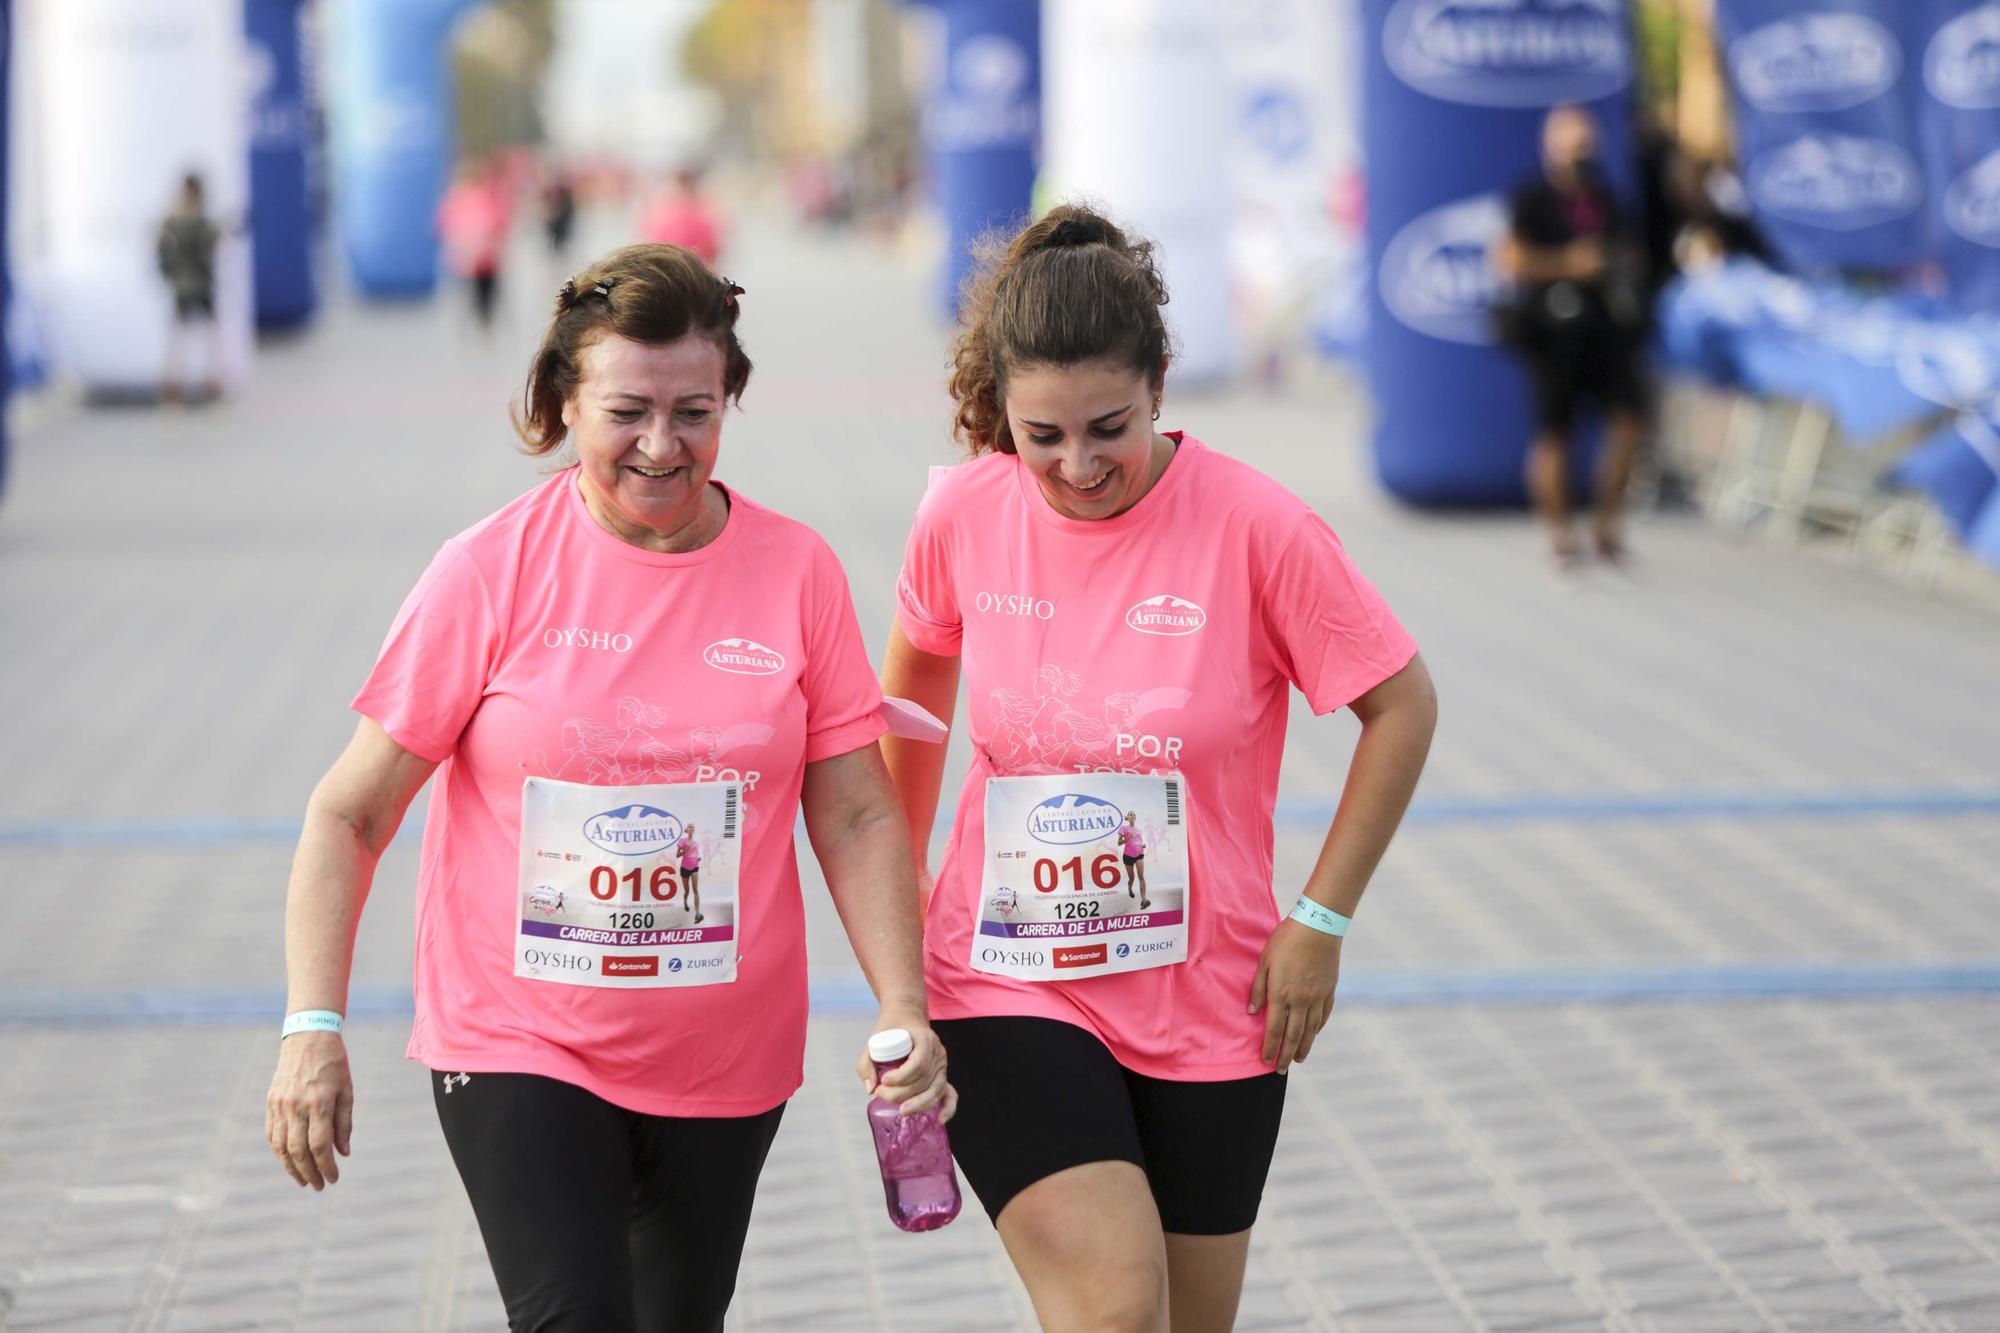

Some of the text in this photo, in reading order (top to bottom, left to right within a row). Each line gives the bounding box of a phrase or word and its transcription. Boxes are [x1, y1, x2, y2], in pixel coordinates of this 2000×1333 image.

[976, 591, 1055, 620] OYSHO
[1133, 610, 1199, 627] ASTURIANA
[543, 627, 633, 653] OYSHO
[710, 649, 779, 669] ASTURIANA
[1116, 733, 1183, 760] POR
[1032, 813, 1115, 832] ASTURIANA
[591, 822, 675, 843] ASTURIANA
[589, 865, 678, 902] 016
[1033, 854, 1121, 894] 016
[1054, 901, 1100, 919] 1262
[609, 912, 655, 929] 1260
[1016, 915, 1150, 936] CARRERA DE LA MUJER
[559, 926, 703, 945] CARRERA DE LA MUJER
[1068, 950, 1101, 962] Santander
[1135, 940, 1173, 953] ZURICH
[524, 949, 592, 972] OYSHO
[618, 962, 652, 970] Santander
[687, 958, 724, 969] ZURICH
[982, 948, 1044, 967] OYSHO
